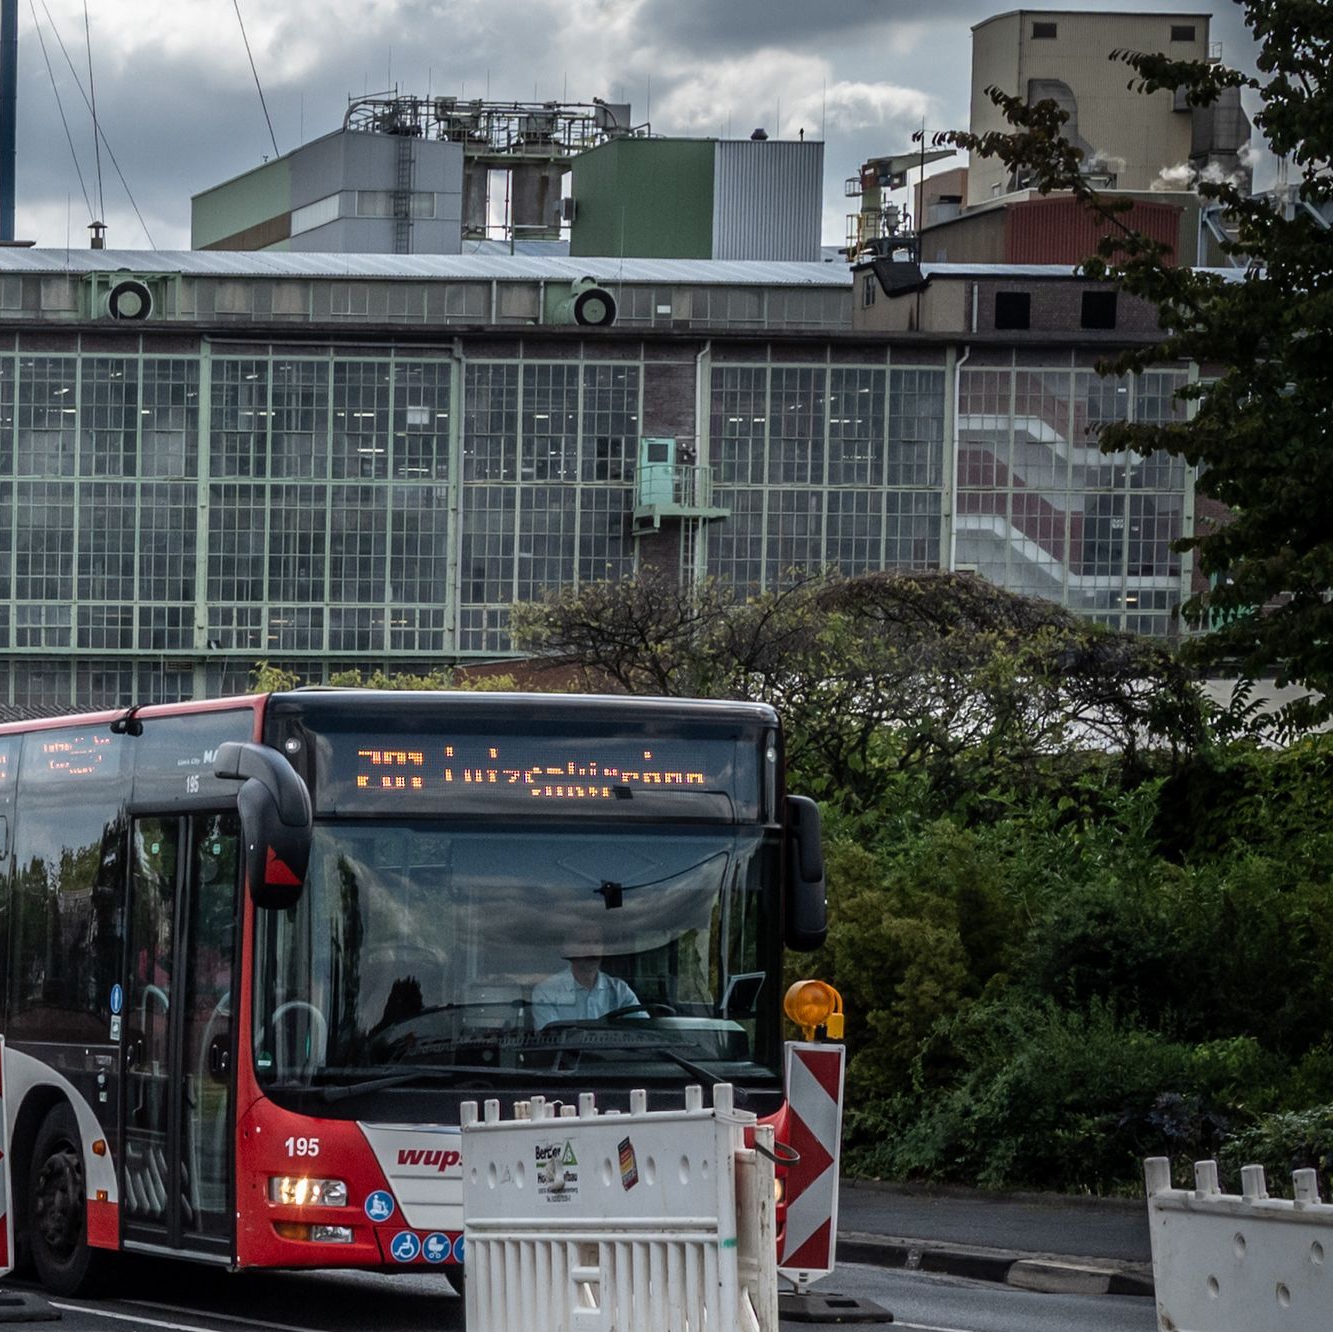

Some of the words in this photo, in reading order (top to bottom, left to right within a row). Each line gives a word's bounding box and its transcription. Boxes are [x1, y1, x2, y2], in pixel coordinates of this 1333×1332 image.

[186, 775, 200, 793] 195
[285, 1137, 320, 1157] 195
[397, 1149, 463, 1172] wup
